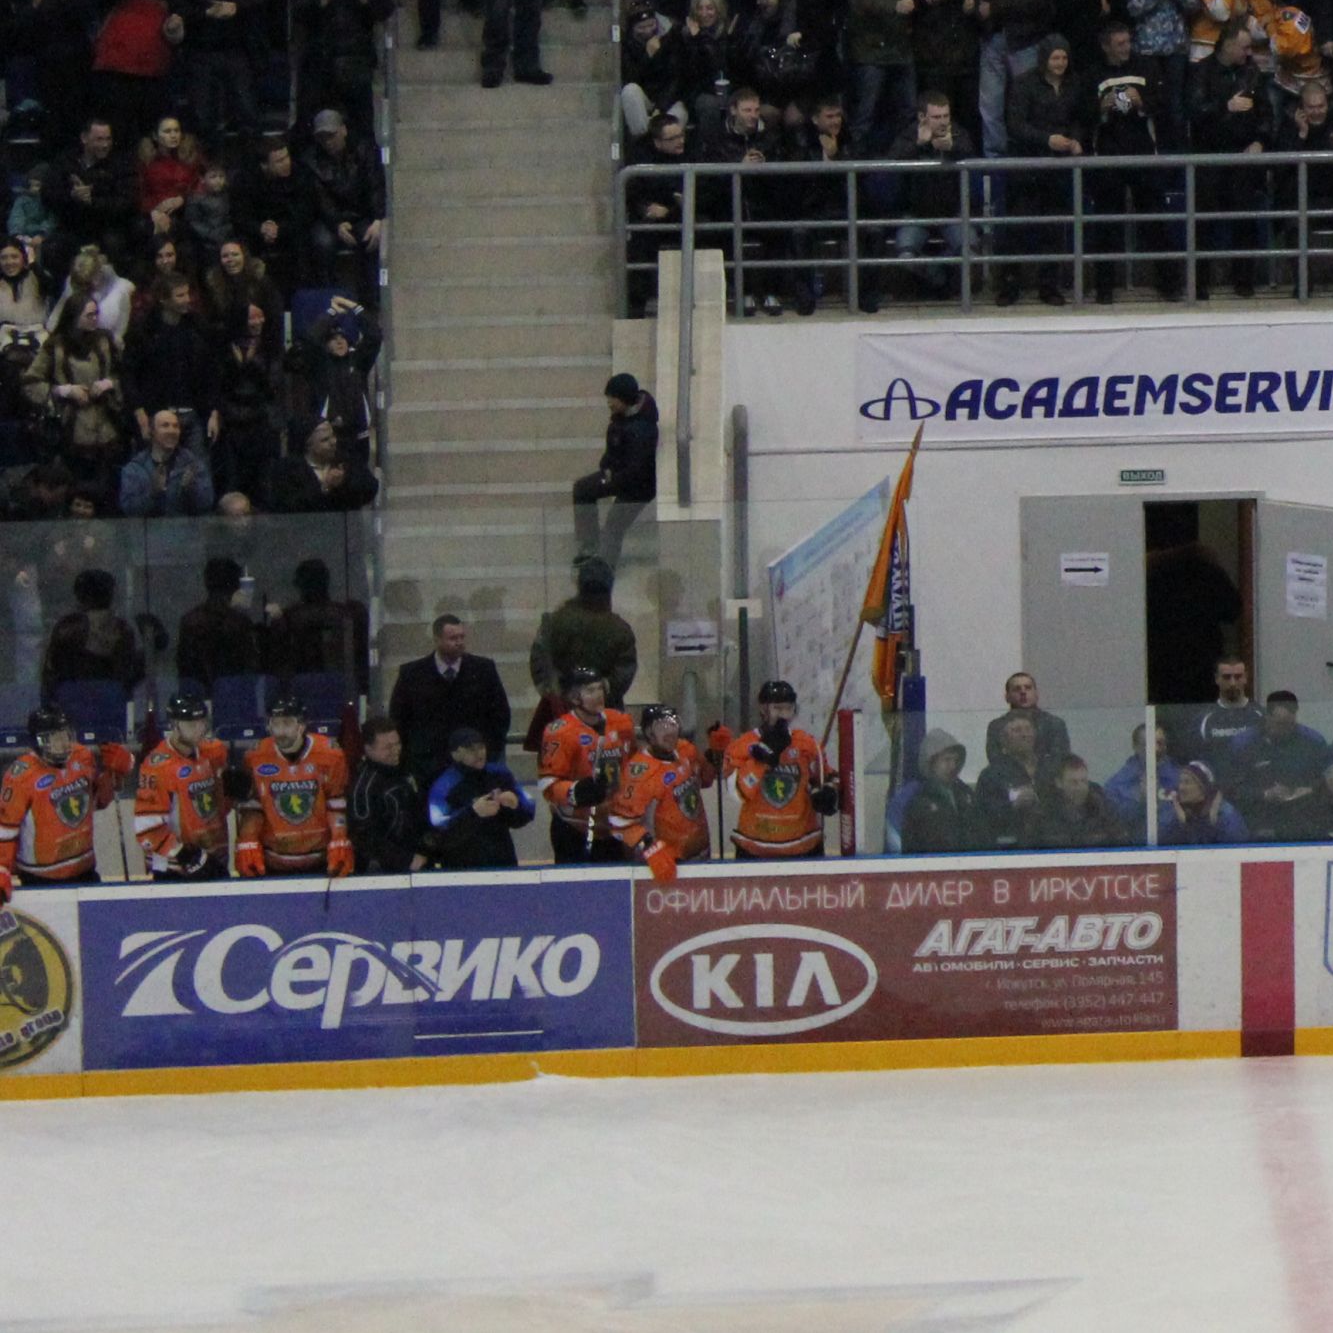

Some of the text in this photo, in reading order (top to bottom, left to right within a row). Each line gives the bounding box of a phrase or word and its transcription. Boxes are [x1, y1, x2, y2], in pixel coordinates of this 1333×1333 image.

[1122, 472, 1164, 482] ВЫХОД
[646, 874, 1160, 915] ОФИЦИАЛЬНЫЙ ДИЛЕР В ИРКУТСКЕ
[913, 912, 1164, 957] АГАТ-АВТО
[192, 924, 601, 1030] Сервико
[692, 951, 842, 1009] KIA
[912, 955, 1164, 973] АВТОМОБИЛИ СЕРВИС ЗАПЧАСТИ
